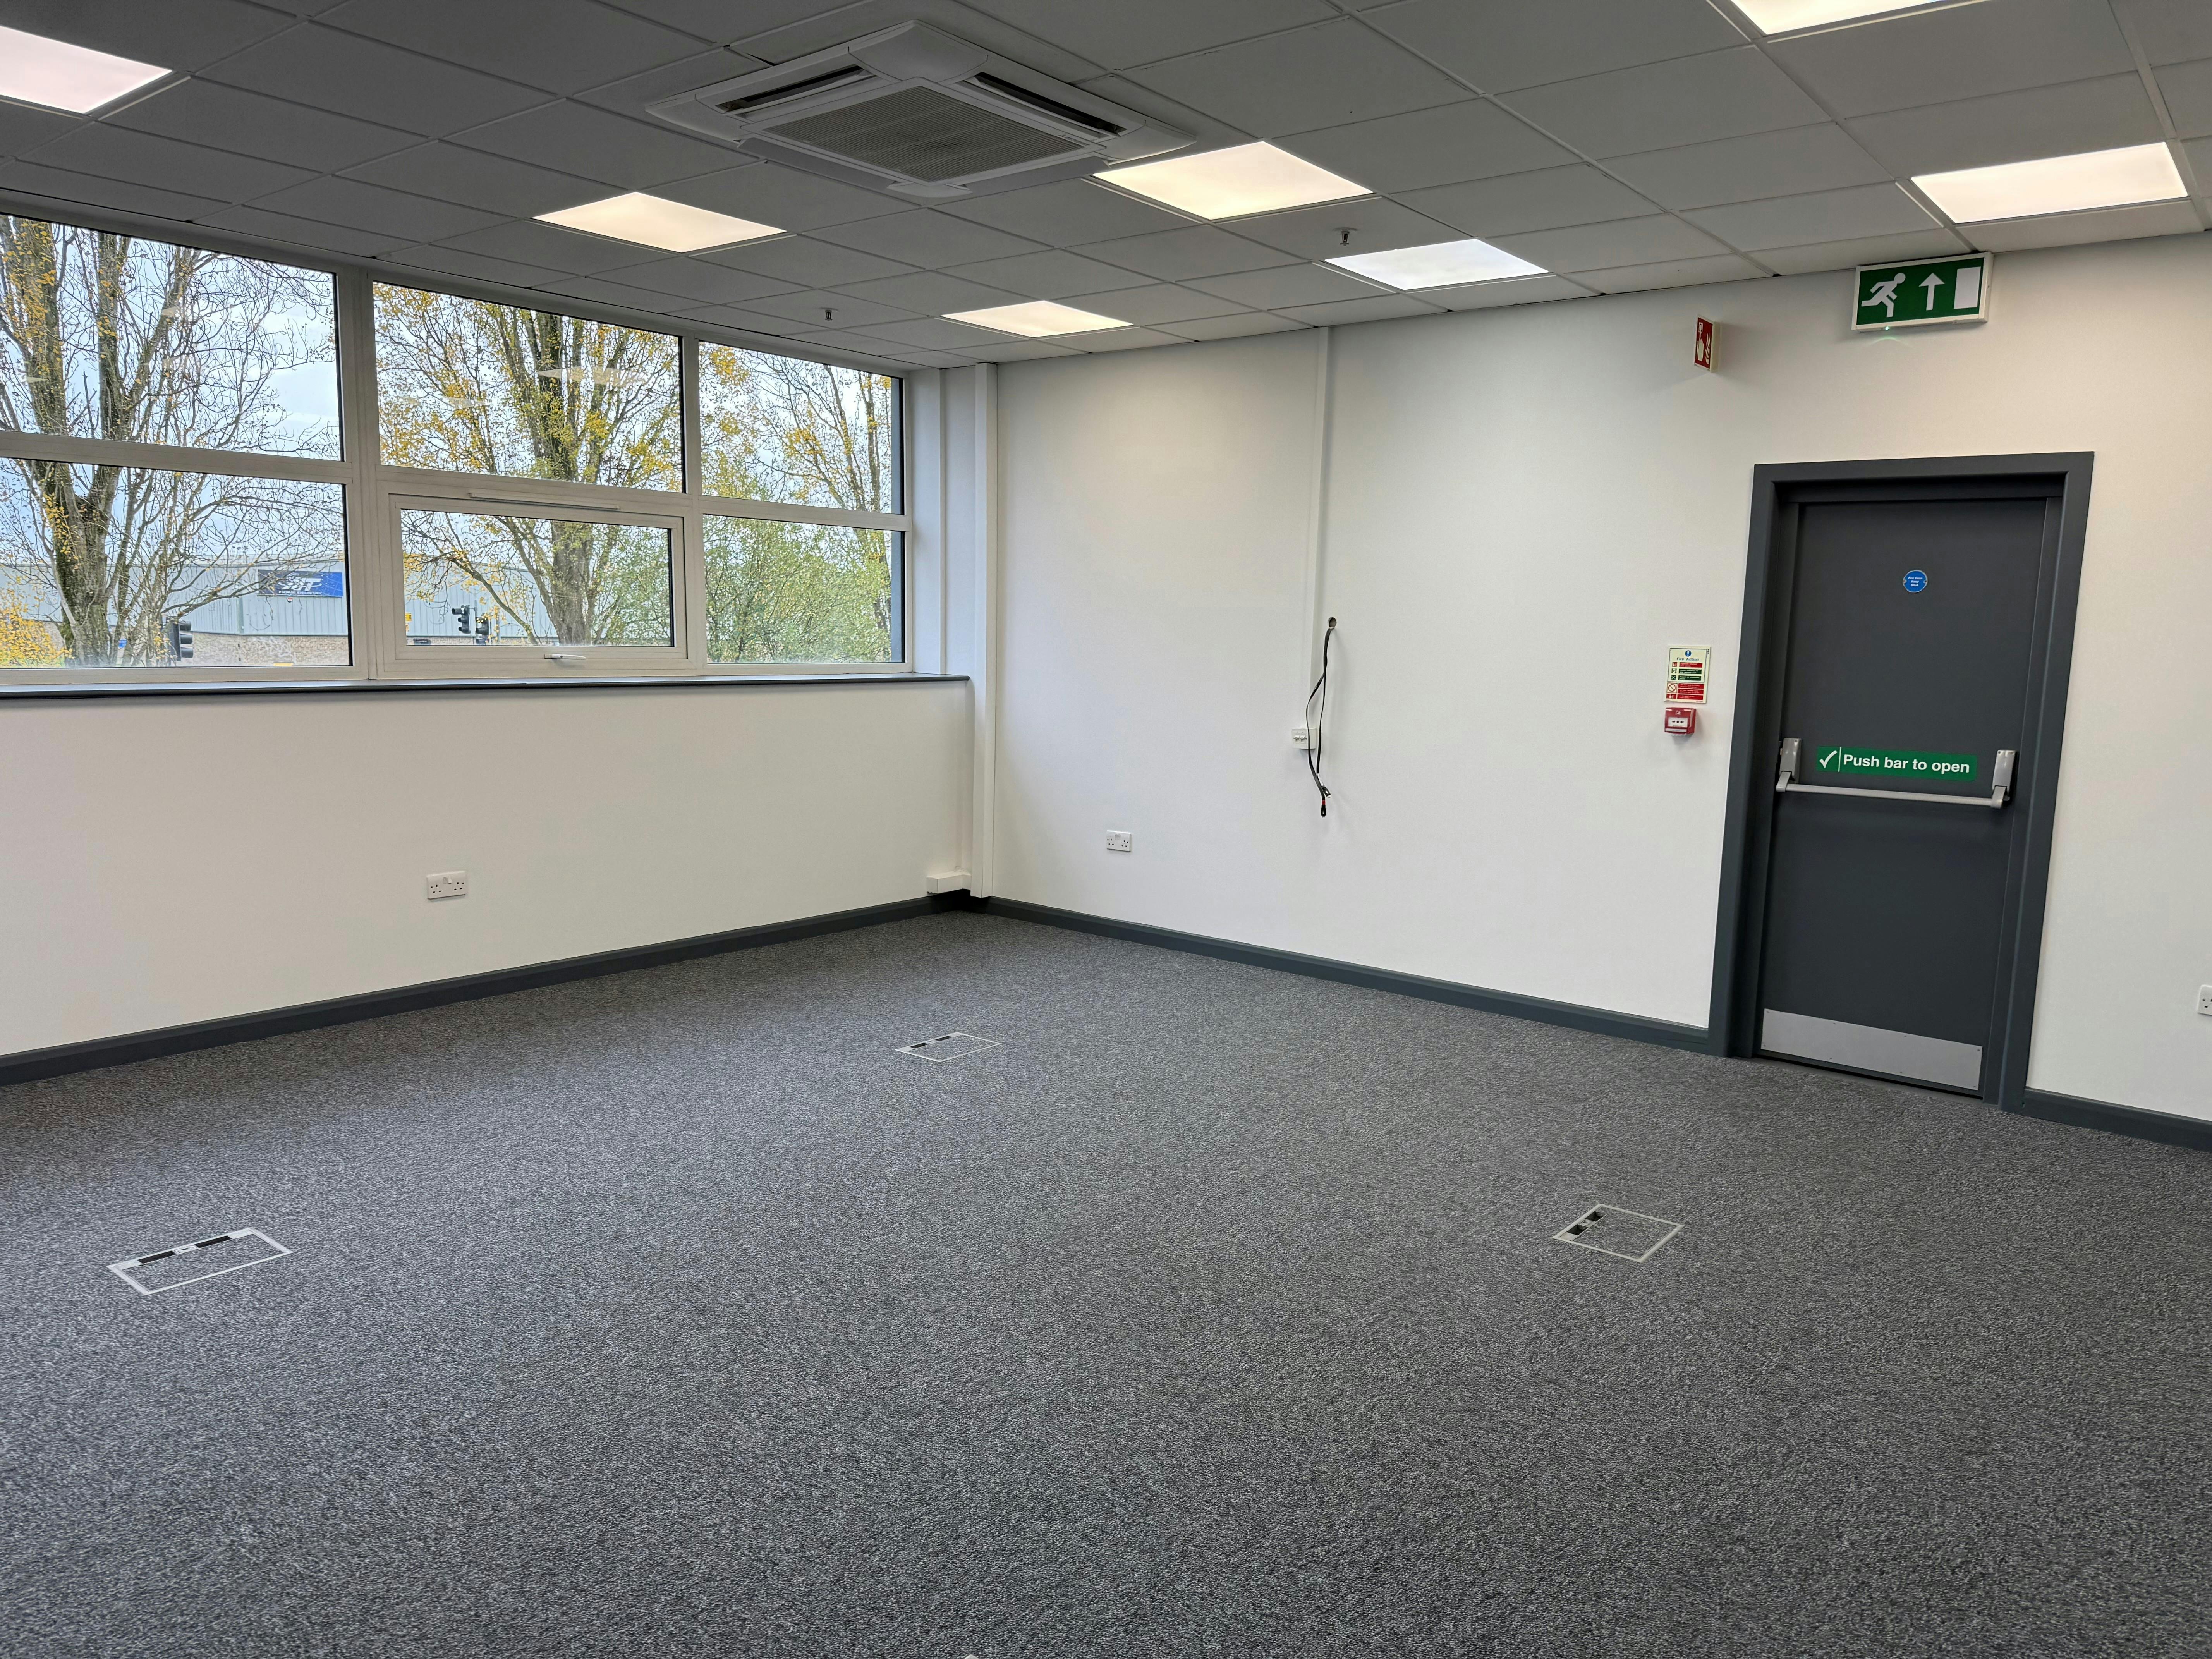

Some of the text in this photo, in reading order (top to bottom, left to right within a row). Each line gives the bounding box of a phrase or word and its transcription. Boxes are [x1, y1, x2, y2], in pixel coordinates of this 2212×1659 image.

[1844, 754, 1970, 775] Push bar to open
